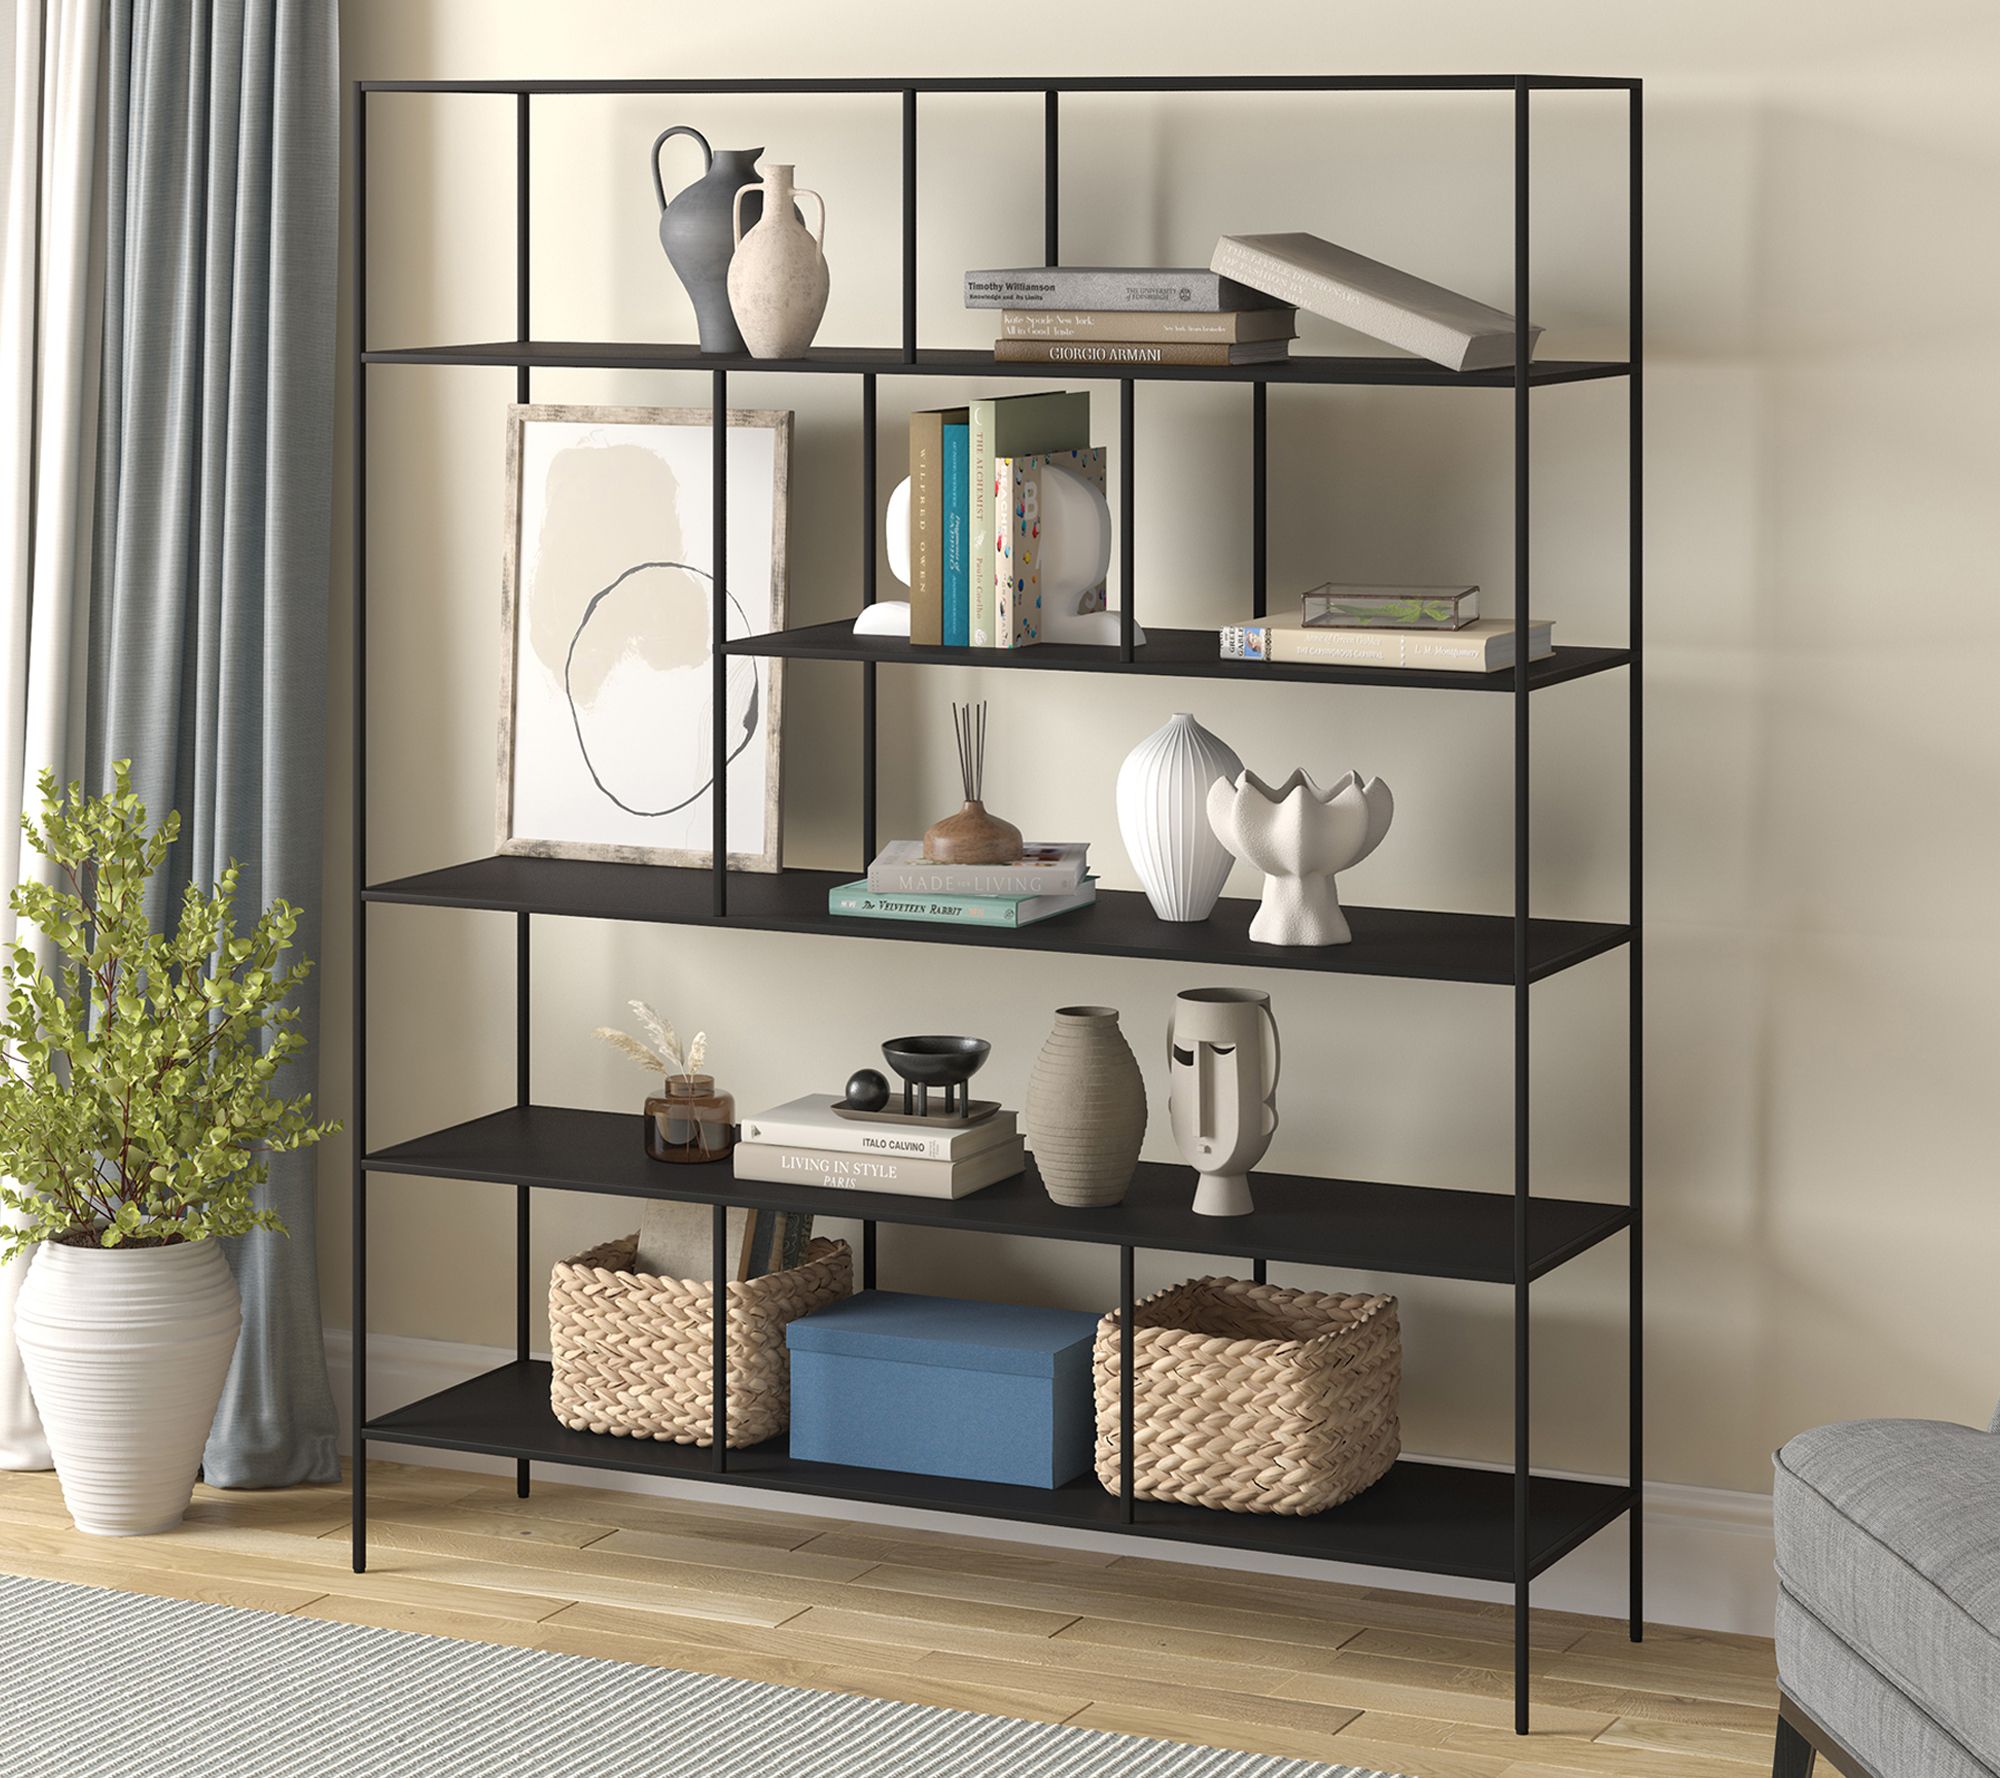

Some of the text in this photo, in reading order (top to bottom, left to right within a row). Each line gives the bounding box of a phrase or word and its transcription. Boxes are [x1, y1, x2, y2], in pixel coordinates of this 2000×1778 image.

[968, 282, 1056, 292] Timothy Williamson
[1004, 314, 1024, 324] Kate
[1026, 315, 1053, 329] Spade
[1056, 315, 1072, 325] New
[1049, 347, 1162, 362] GIORGIO ARMANI
[976, 431, 984, 522] THE ALCHEMIST
[976, 557, 984, 620] Paulo Coelho
[899, 875, 953, 891] MADE
[974, 876, 1042, 892] LIVING
[862, 900, 875, 910] The
[879, 900, 926, 913] VELVETEEN
[929, 903, 963, 916] RABBIT
[863, 1138, 887, 1149] ITALO
[889, 1140, 925, 1152] CALVINO
[781, 1155, 897, 1179] LIVING IN STYLE
[823, 1175, 857, 1189] PARIS
